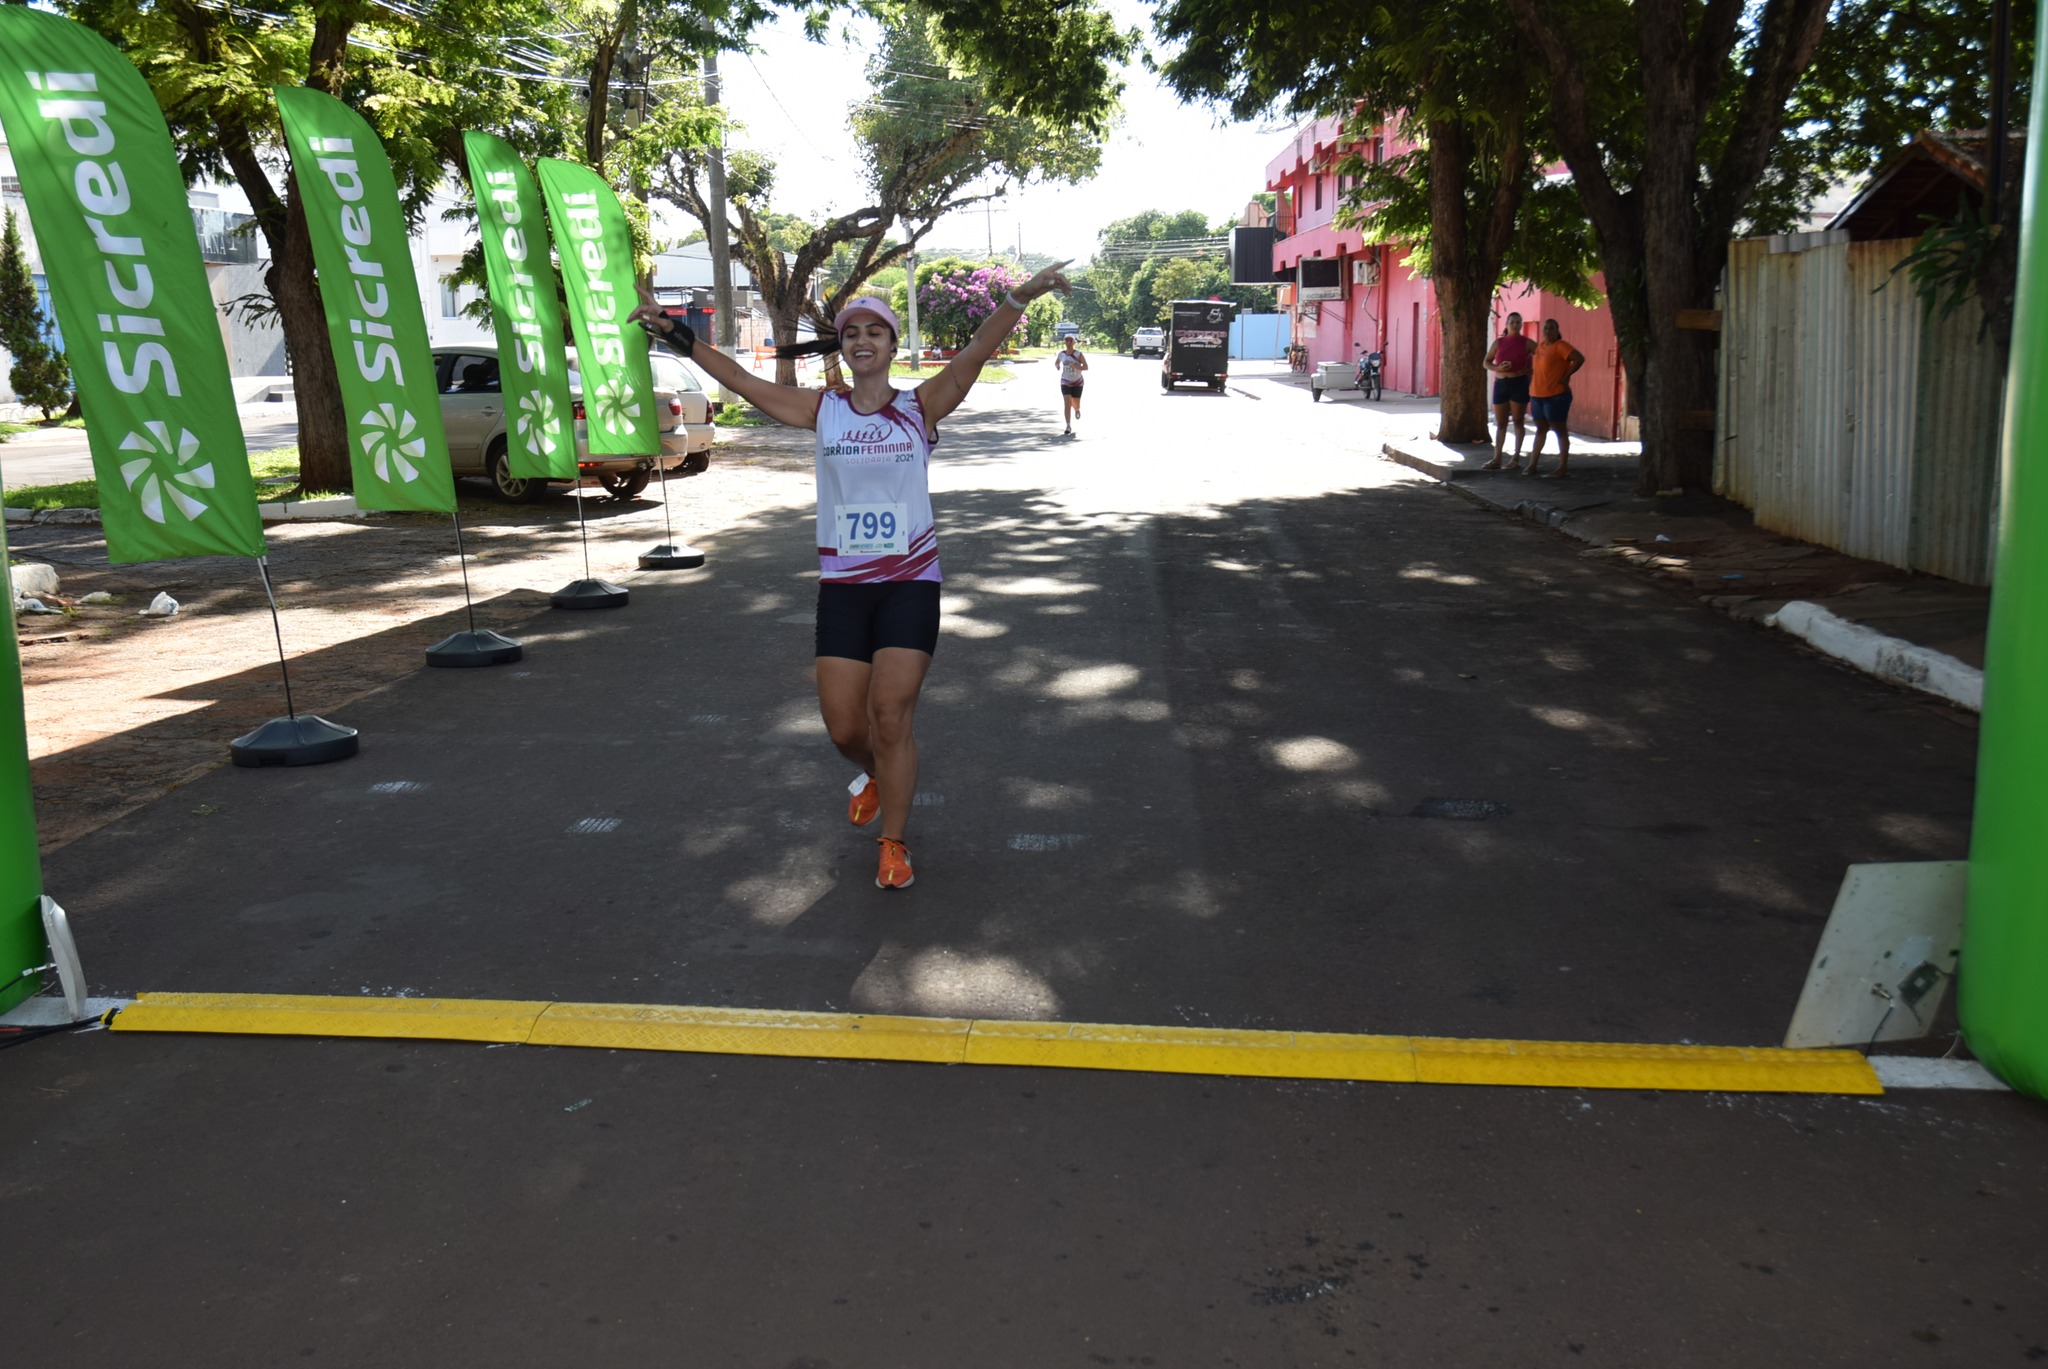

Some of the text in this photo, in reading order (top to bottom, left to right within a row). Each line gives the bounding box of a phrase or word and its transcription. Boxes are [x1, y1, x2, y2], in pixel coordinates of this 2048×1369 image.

[24, 71, 182, 397] Sicredi
[309, 136, 405, 387] Sicredi
[485, 166, 546, 376] Sicredi
[562, 189, 626, 367] Sicredi
[823, 442, 912, 457] CORRIDA FEMININA
[846, 511, 896, 540] 799
[895, 453, 914, 463] 2021
